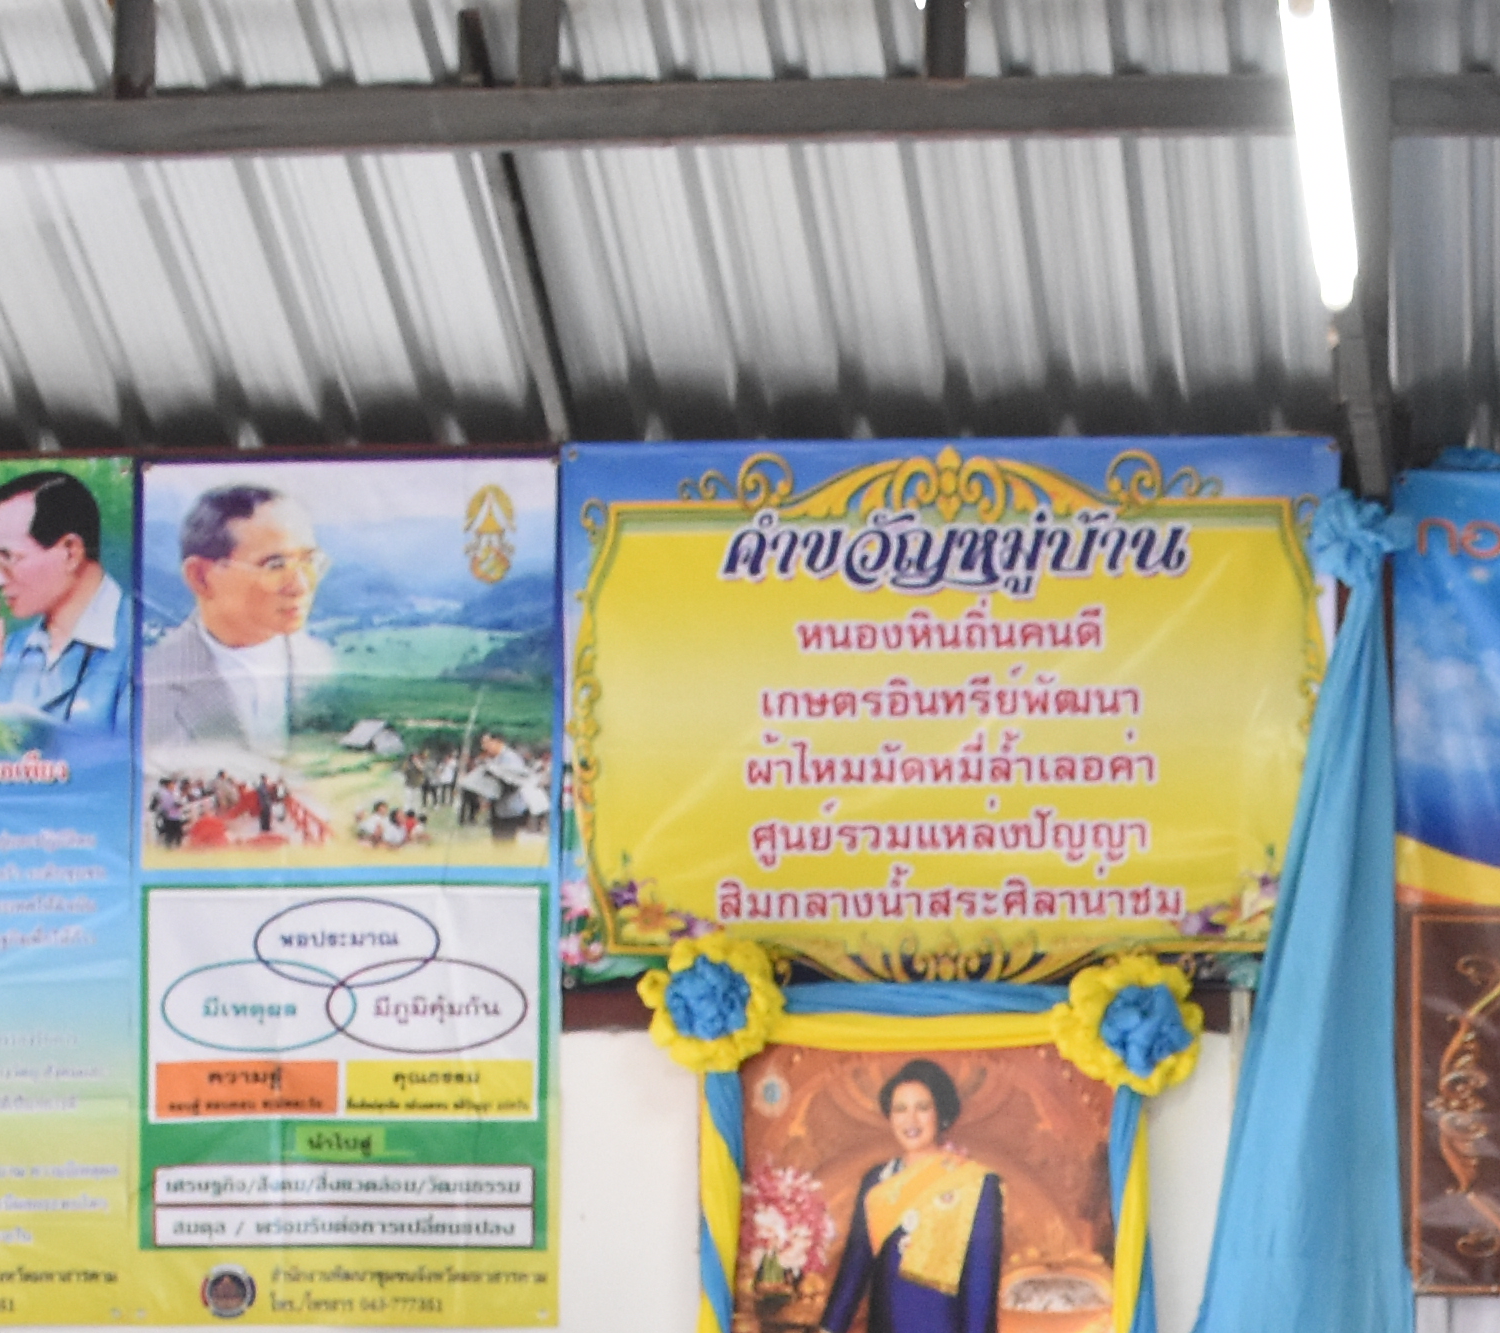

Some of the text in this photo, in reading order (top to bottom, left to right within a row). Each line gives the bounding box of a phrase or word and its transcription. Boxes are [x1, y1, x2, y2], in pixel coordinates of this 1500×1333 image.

[719, 507, 1188, 596] คำขวัญหมู่บ้าน
[797, 599, 1103, 653] หนองหินถิ่นคนดี
[760, 666, 1141, 720] เกษตรอินทรีย์พัฒนา
[745, 729, 1156, 788] ผ้าไหมมัดหมี่ล้ำเลอค่า
[751, 799, 1148, 865] ศูนย์รวมแหล่งปัญญา
[716, 865, 1183, 923] สิมกลางน้ำสระศิลาน่าชม
[280, 928, 401, 950] พอประมาณ
[201, 995, 299, 1026] มีเหตุผล
[373, 993, 502, 1027] มีภูมิคุ้มกัน
